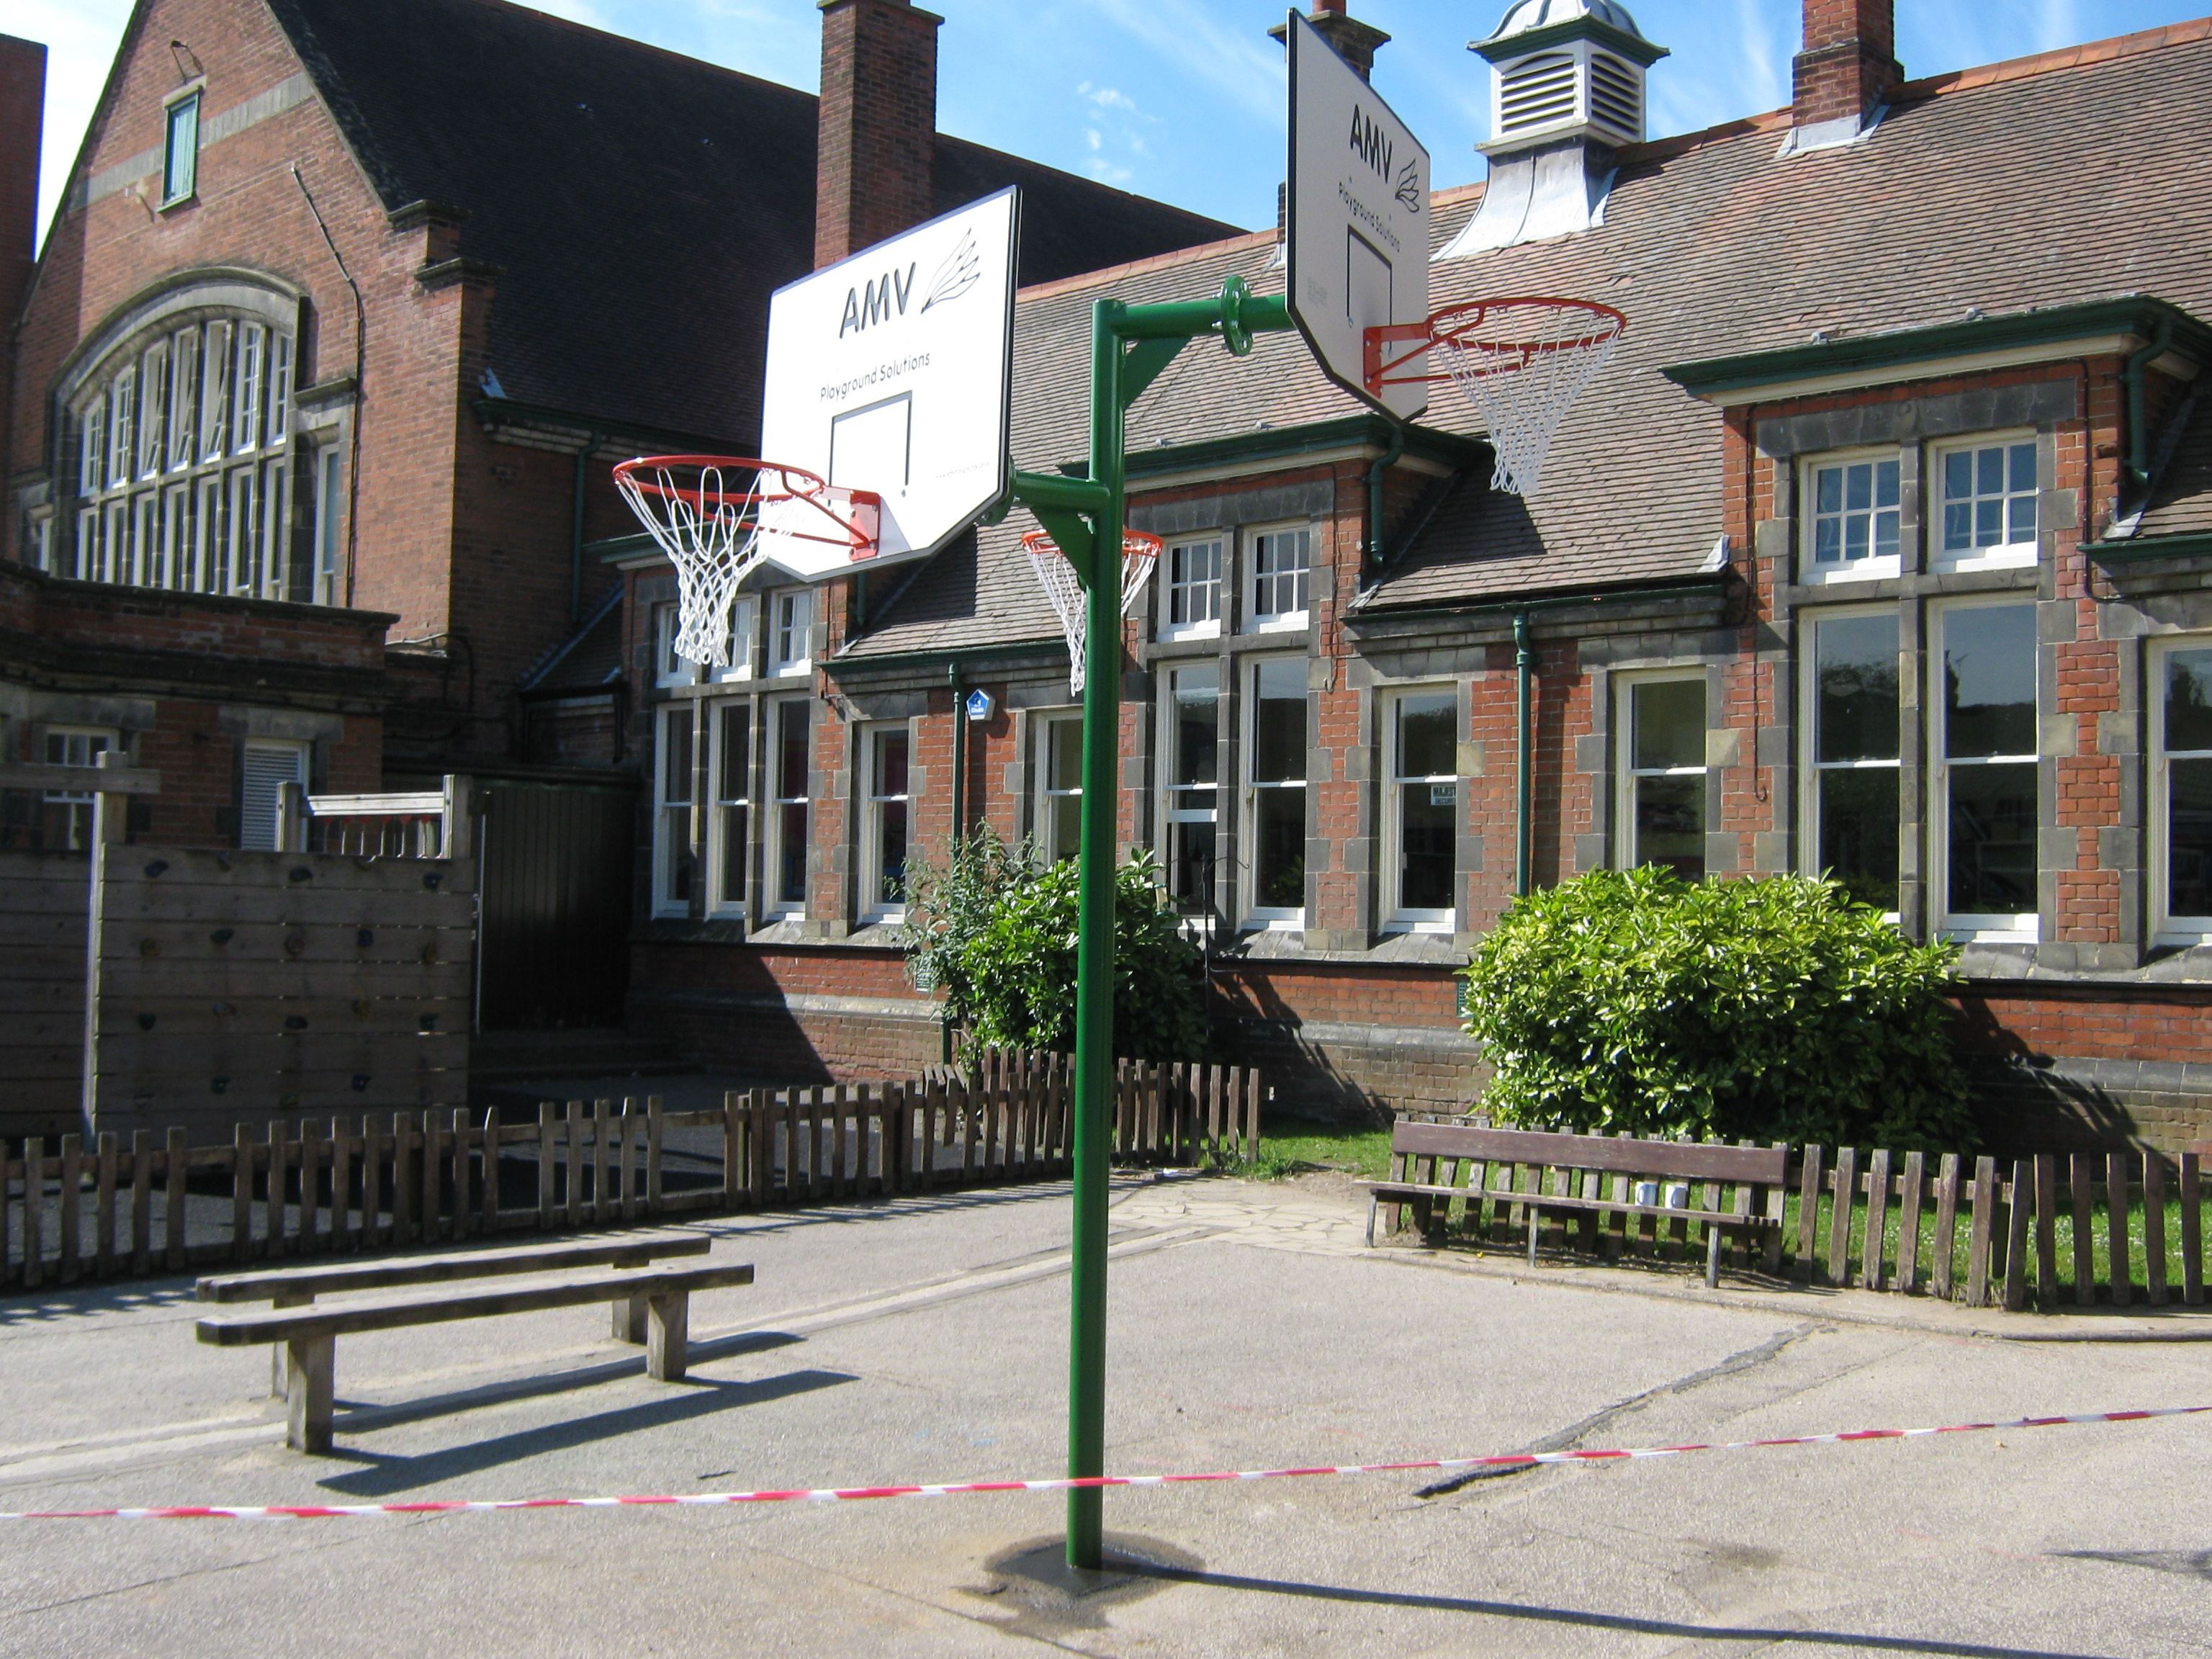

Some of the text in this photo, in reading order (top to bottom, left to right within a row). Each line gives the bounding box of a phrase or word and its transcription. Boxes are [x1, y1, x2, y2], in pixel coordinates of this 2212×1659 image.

[1350, 103, 1393, 184] AMV
[839, 261, 916, 339] AMV
[820, 352, 930, 403] Playground Solutions
